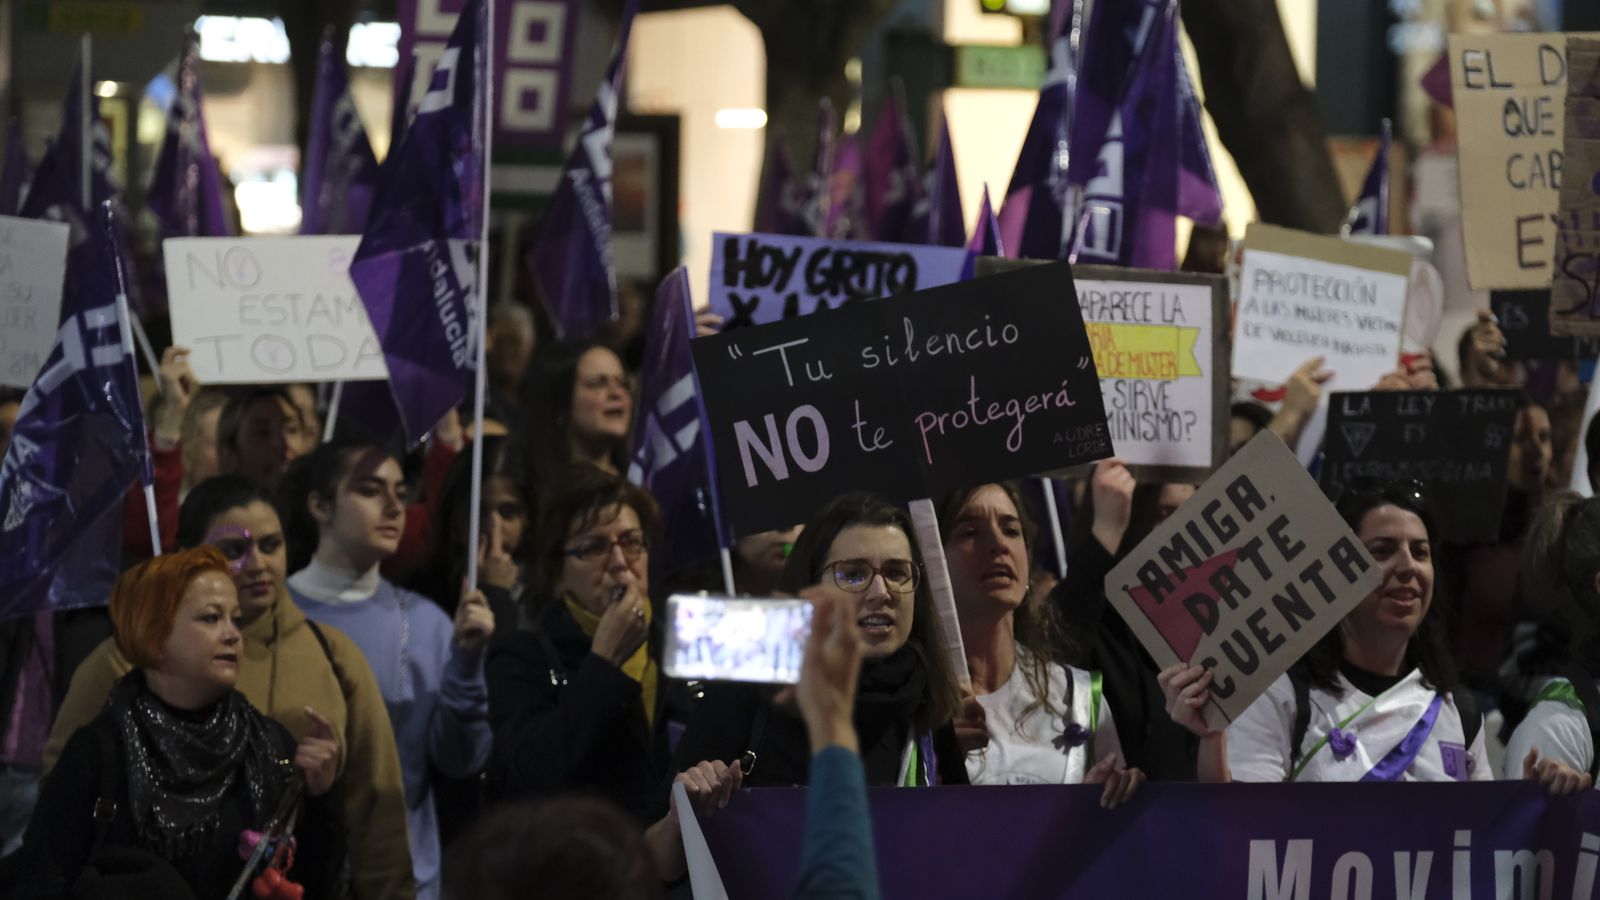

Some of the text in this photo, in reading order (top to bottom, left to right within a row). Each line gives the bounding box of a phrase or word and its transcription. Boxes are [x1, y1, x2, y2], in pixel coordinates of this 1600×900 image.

[1463, 45, 1567, 89] EL D
[1502, 96, 1555, 137] QUE
[1506, 149, 1564, 190] CAB
[1516, 213, 1561, 269] E
[186, 246, 262, 290] NO
[723, 237, 917, 298] HOY GRITO
[239, 293, 364, 327] ESTAM
[1161, 293, 1187, 323] LA
[1243, 299, 1260, 314] A
[192, 333, 382, 374] TODA
[860, 314, 1019, 368] silencio
[1112, 380, 1173, 412] SIRVE
[1341, 396, 1371, 417] LA
[1396, 394, 1436, 416] LEY
[733, 403, 830, 488] NO
[851, 399, 894, 452] te
[1136, 473, 1277, 606] AMIGA,
[1181, 513, 1307, 638] DATE
[1199, 535, 1371, 700] CUENTA
